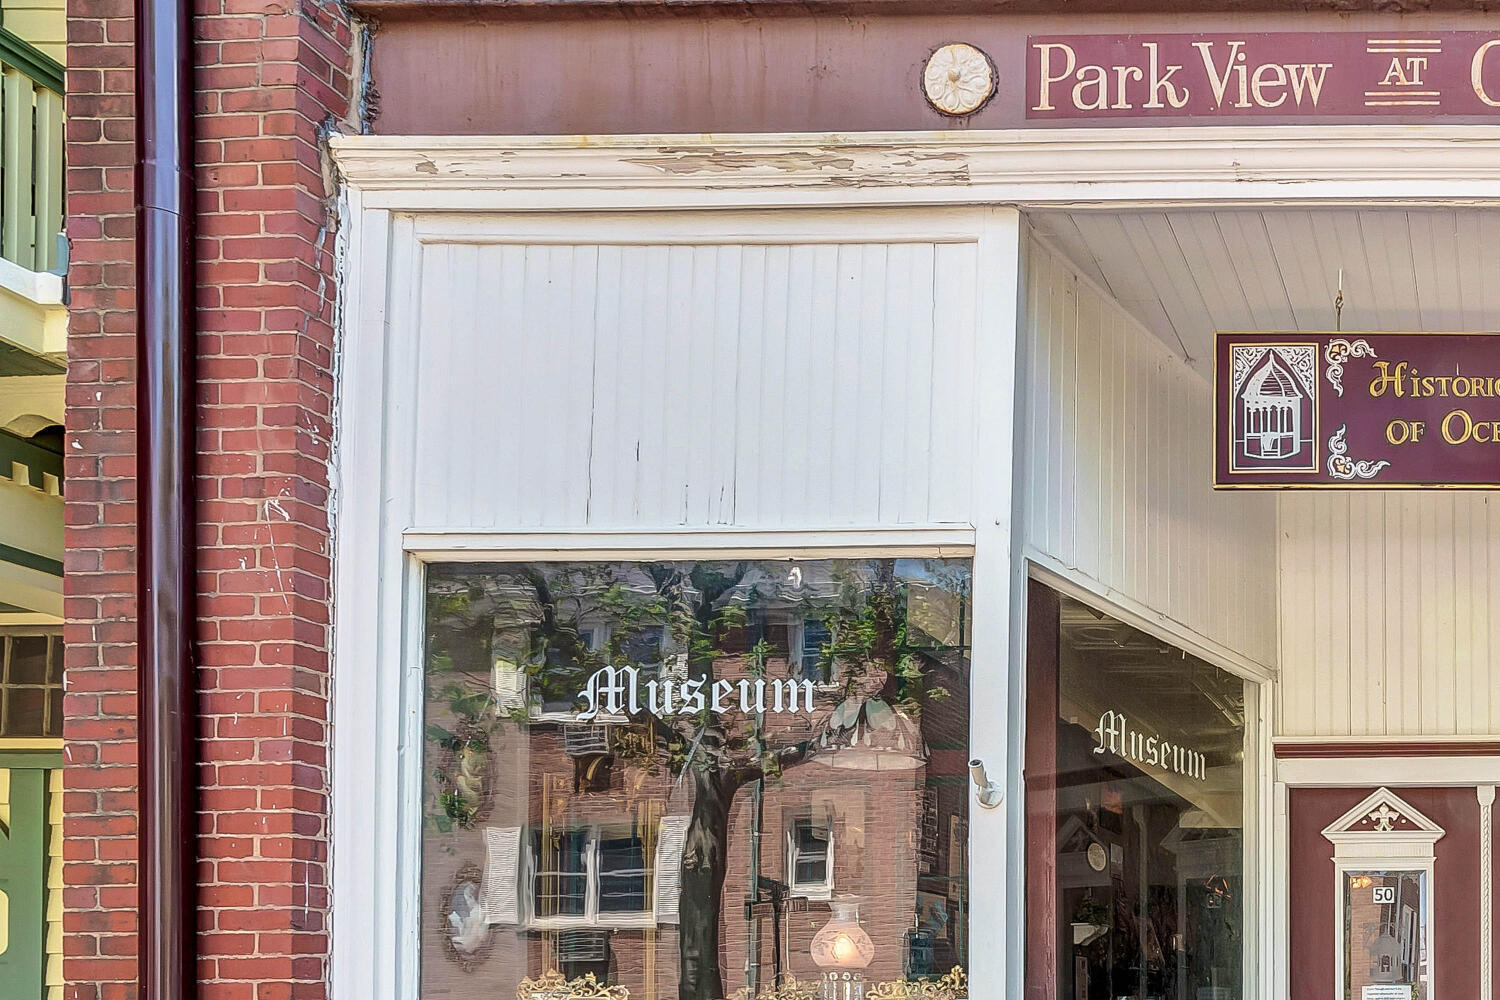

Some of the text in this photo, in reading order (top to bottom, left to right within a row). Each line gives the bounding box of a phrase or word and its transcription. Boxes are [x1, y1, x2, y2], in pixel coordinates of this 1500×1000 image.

[1031, 42, 1190, 111] Park
[1191, 40, 1333, 109] View
[1377, 56, 1428, 86] AT
[1385, 418, 1426, 445] OF
[576, 664, 817, 722] Museum
[1093, 709, 1206, 781] Museum
[1374, 888, 1393, 902] 50
